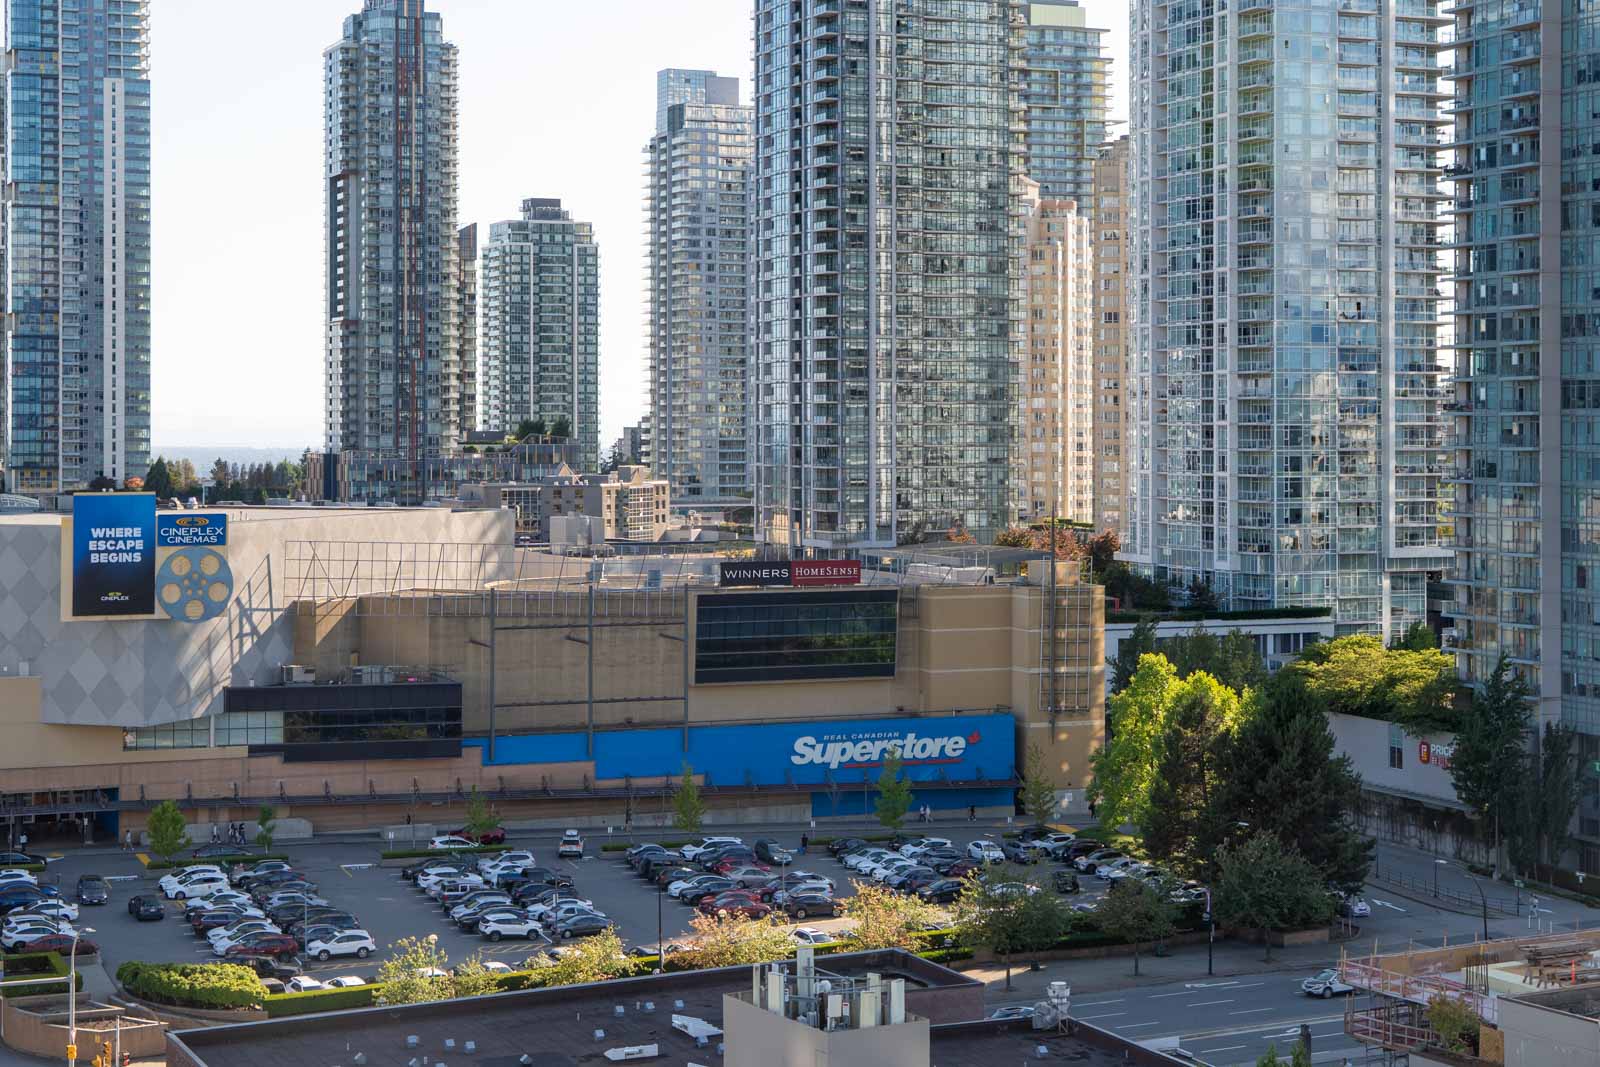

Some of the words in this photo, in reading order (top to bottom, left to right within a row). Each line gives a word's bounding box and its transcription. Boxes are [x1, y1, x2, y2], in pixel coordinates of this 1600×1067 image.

[91, 527, 142, 538] WHERE
[160, 527, 224, 536] CINEPLEX
[88, 540, 144, 551] ESCAPE
[167, 536, 218, 544] CINEMAS
[90, 552, 142, 563] BEGINS
[724, 568, 789, 579] WINNERS
[851, 731, 900, 740] CANADIAN
[791, 732, 967, 770] Superstore
[1430, 743, 1455, 757] PRICE
